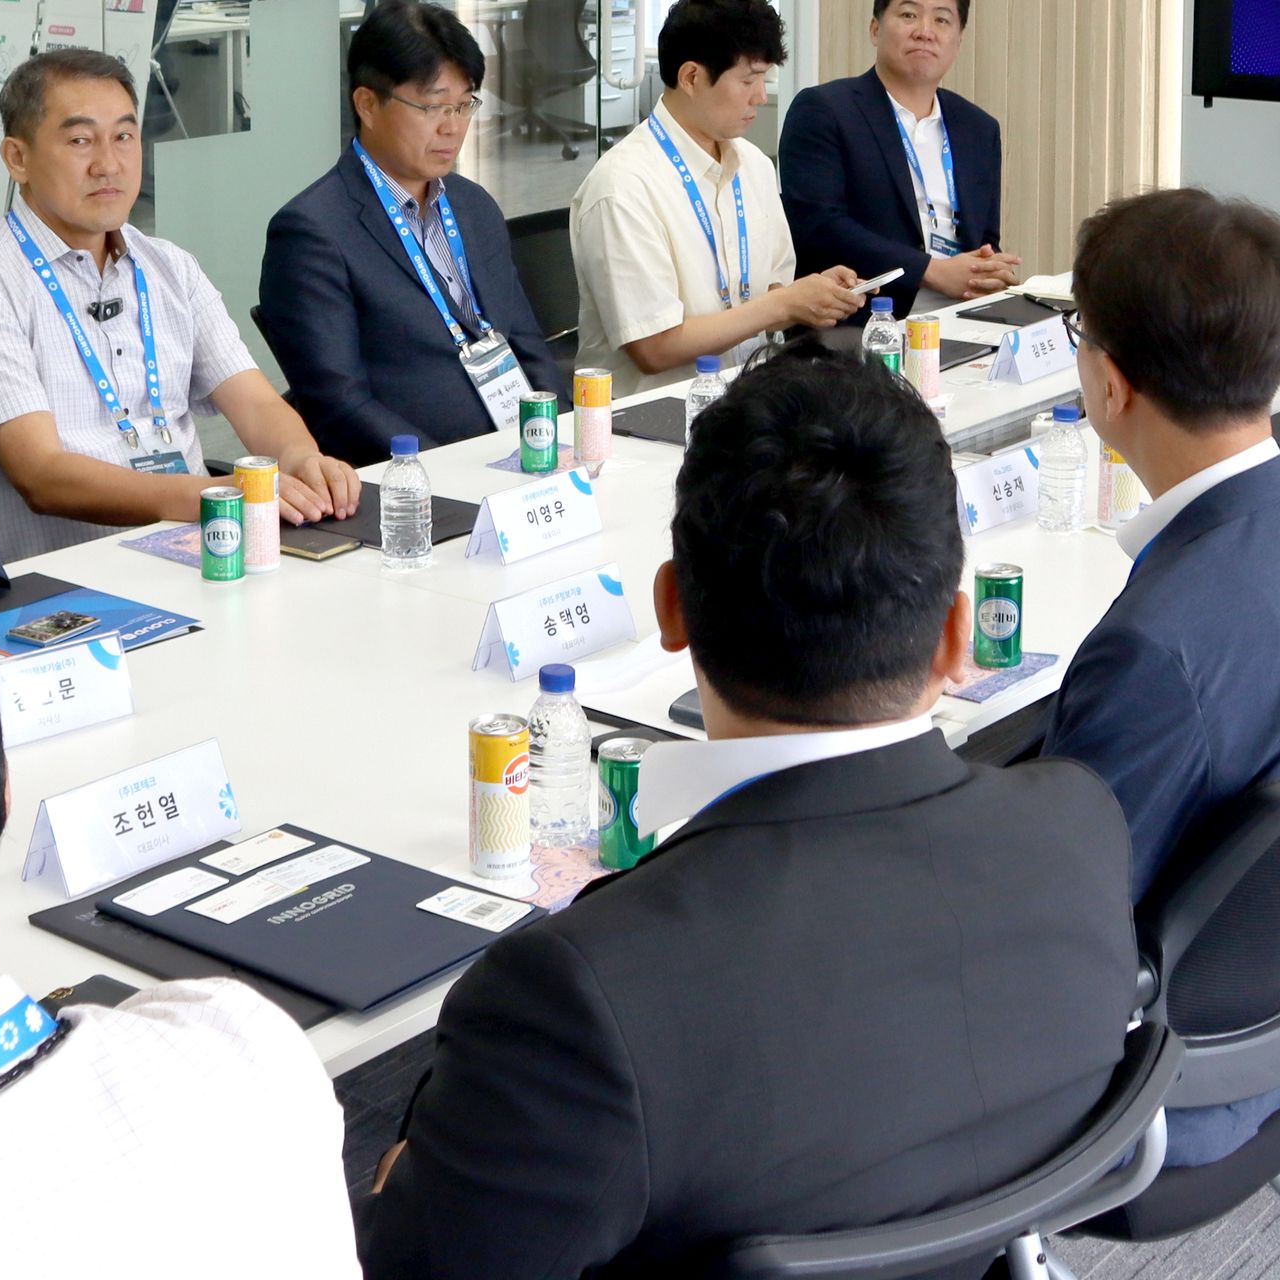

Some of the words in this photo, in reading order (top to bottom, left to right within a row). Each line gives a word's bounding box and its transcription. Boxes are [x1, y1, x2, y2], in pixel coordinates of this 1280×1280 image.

[414, 255, 436, 294] INNOGRID
[140, 292, 152, 337] INNOGRID
[66, 312, 92, 358] INNOGRID
[526, 428, 554, 439] TREVI
[206, 531, 238, 542] TREVI
[981, 612, 1016, 624] 트레비
[267, 883, 356, 925] INNOGRID
